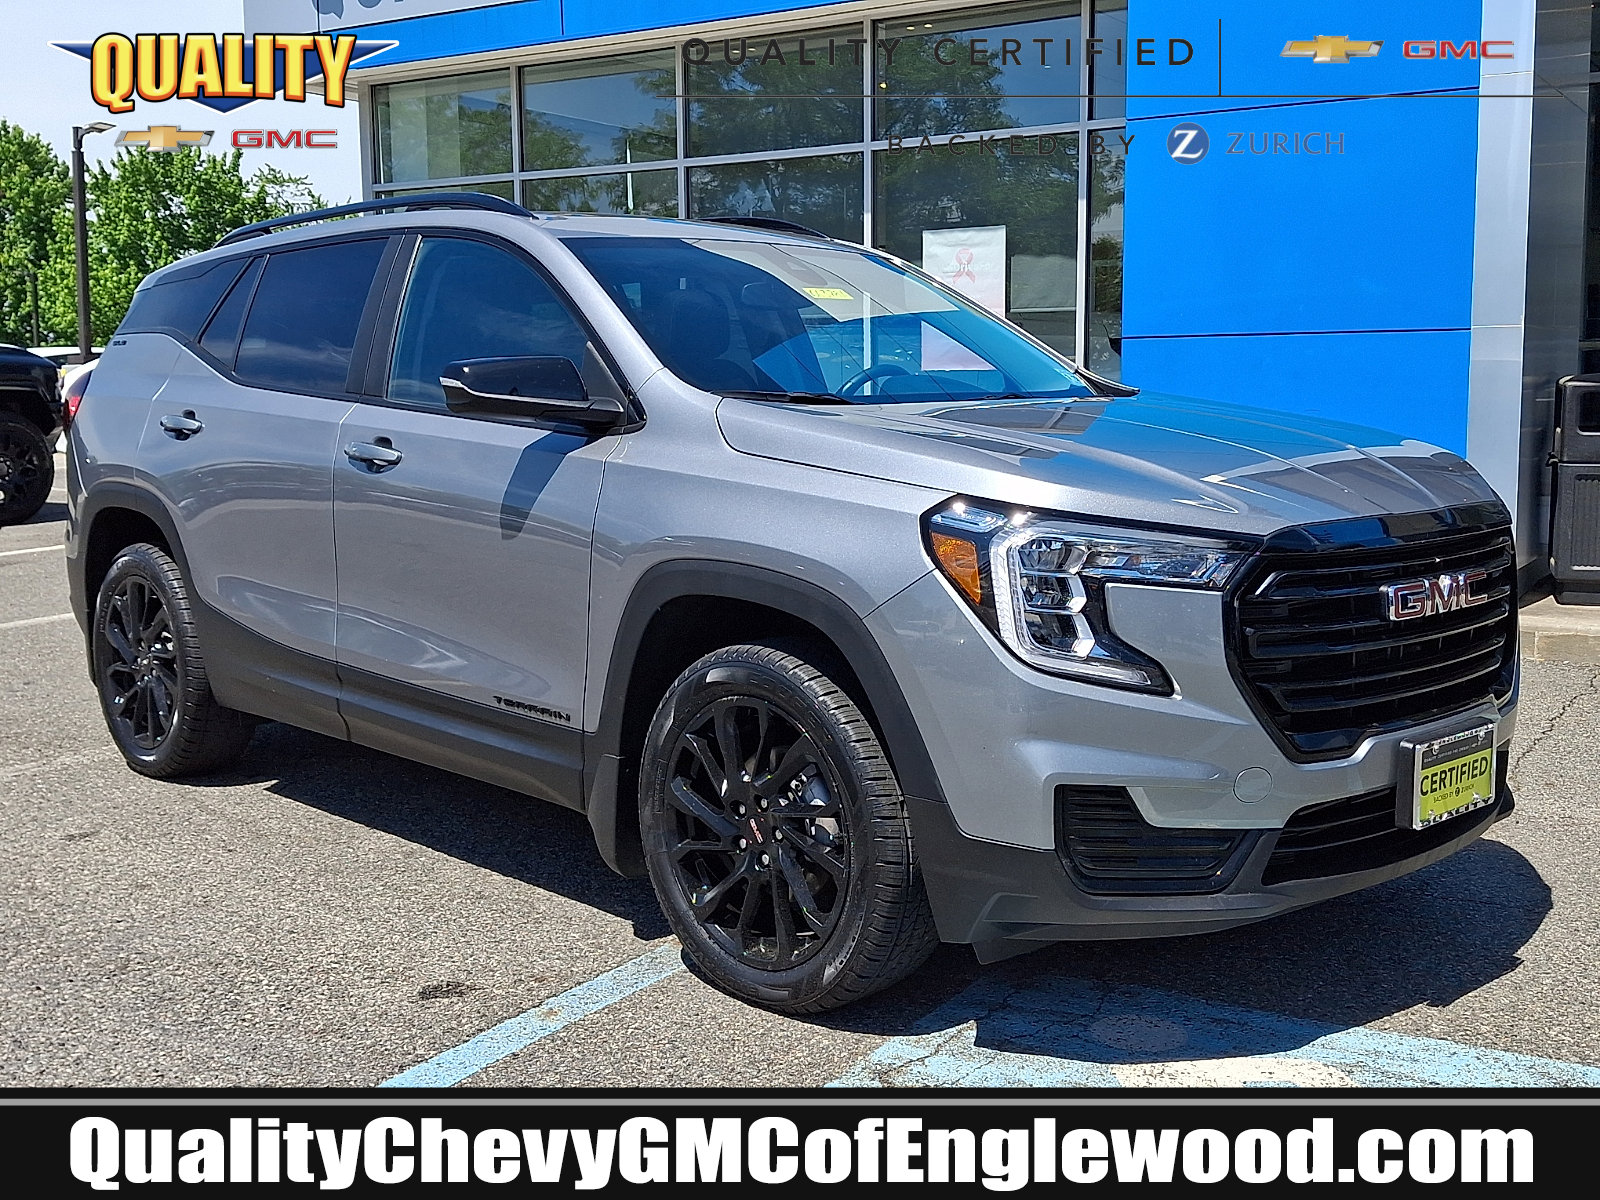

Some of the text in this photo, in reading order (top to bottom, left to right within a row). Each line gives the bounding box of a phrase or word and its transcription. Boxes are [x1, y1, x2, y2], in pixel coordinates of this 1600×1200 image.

[1387, 571, 1488, 621] GMC
[493, 695, 571, 722] TERRAIN
[1420, 756, 1489, 797] CERTIFIED
